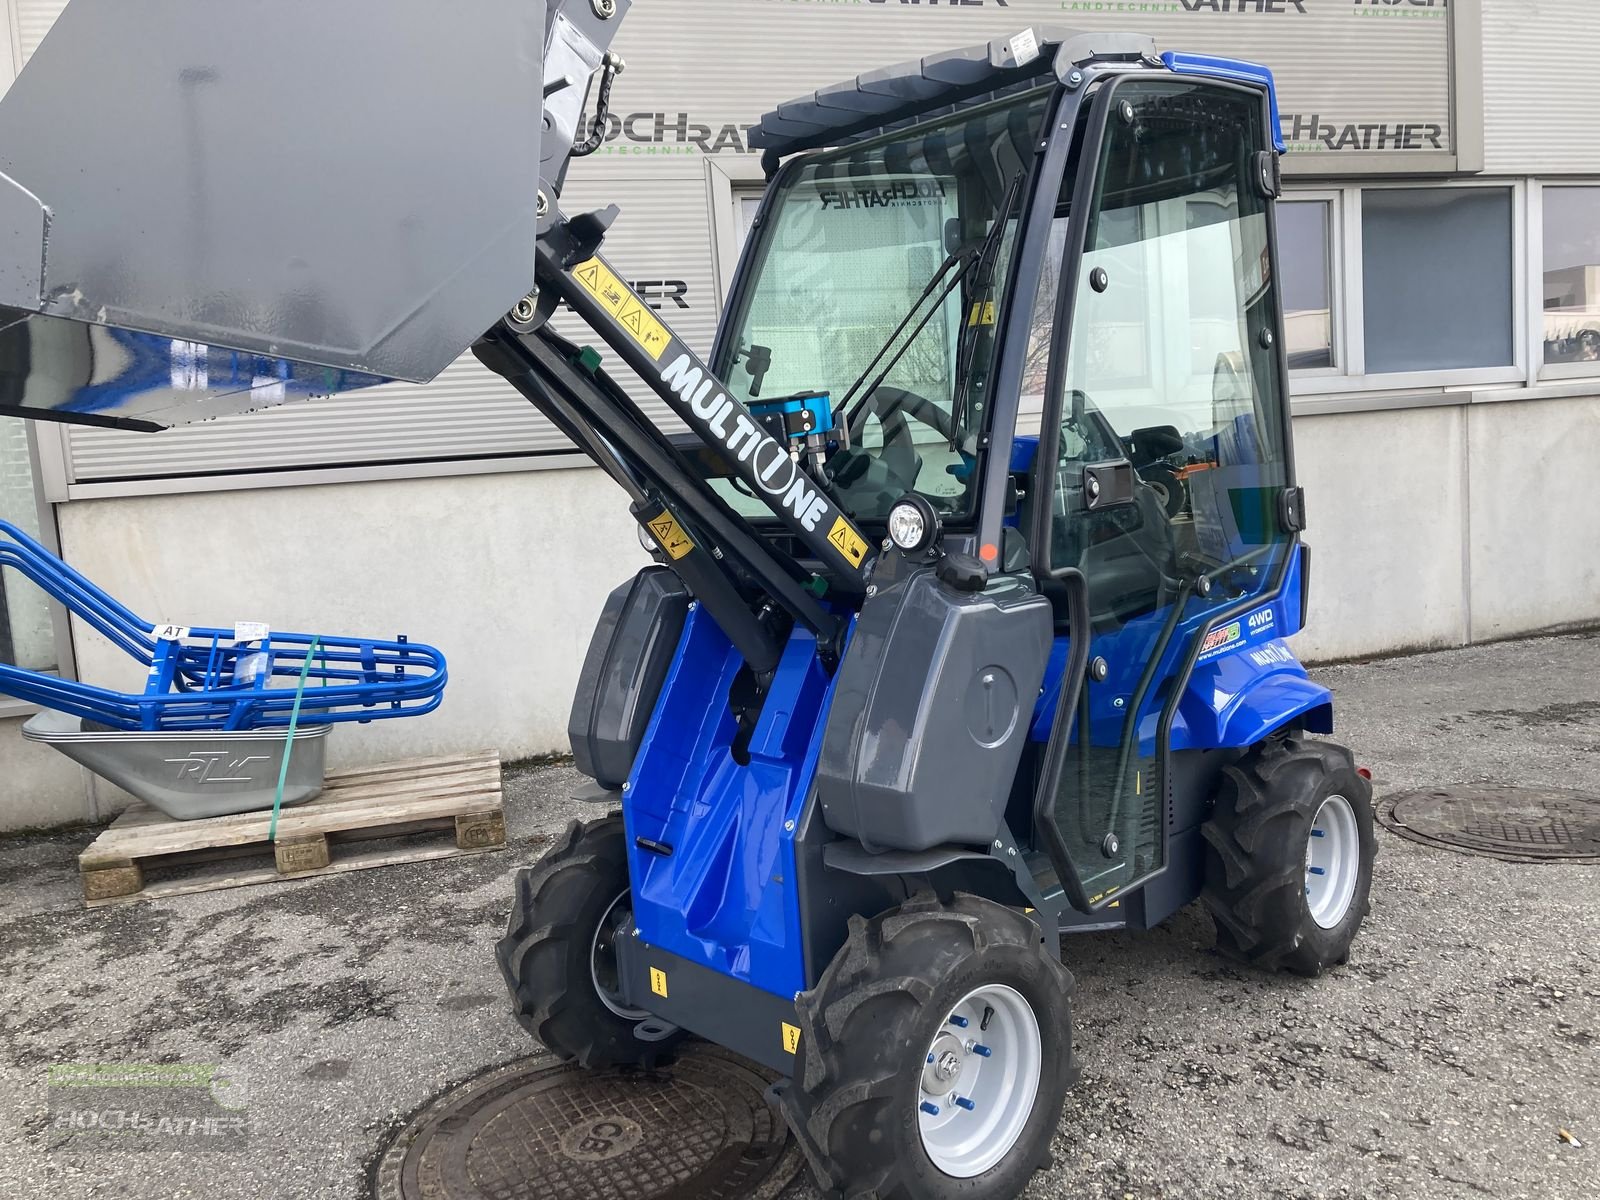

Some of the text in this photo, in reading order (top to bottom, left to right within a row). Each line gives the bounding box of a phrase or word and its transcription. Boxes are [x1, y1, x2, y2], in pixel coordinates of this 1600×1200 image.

[1060, 1, 1180, 12] LANDTECHNIK
[1353, 8, 1447, 17] LANDTECHNI
[1249, 609, 1273, 627] 4WD
[163, 625, 184, 637] AT
[1198, 640, 1247, 660] www.multione.com
